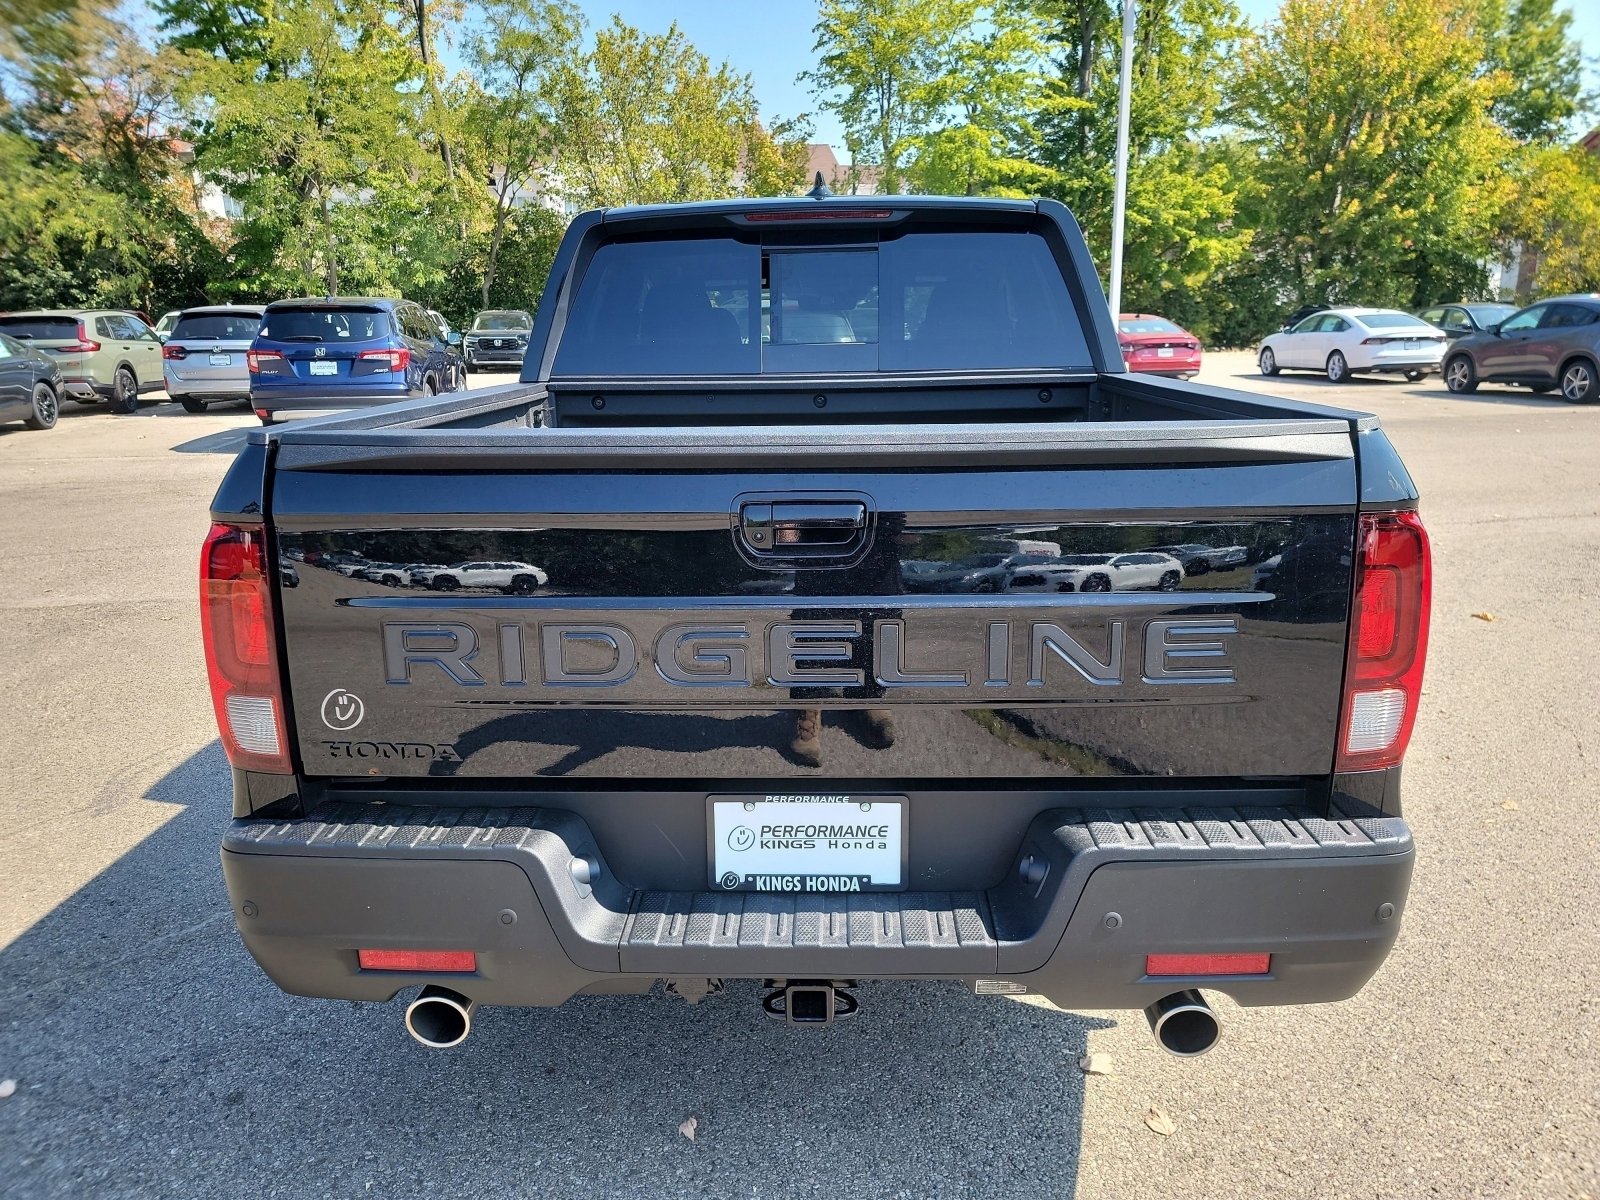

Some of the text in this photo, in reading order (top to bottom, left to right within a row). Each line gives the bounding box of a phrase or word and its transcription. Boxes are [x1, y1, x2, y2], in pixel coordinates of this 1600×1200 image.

[382, 616, 1239, 687] RIDGELINE
[321, 741, 463, 761] HONDA
[760, 825, 888, 837] PERFORMANCE
[760, 840, 887, 849] KINGS Honda
[756, 876, 860, 891] KINGS HONDA
